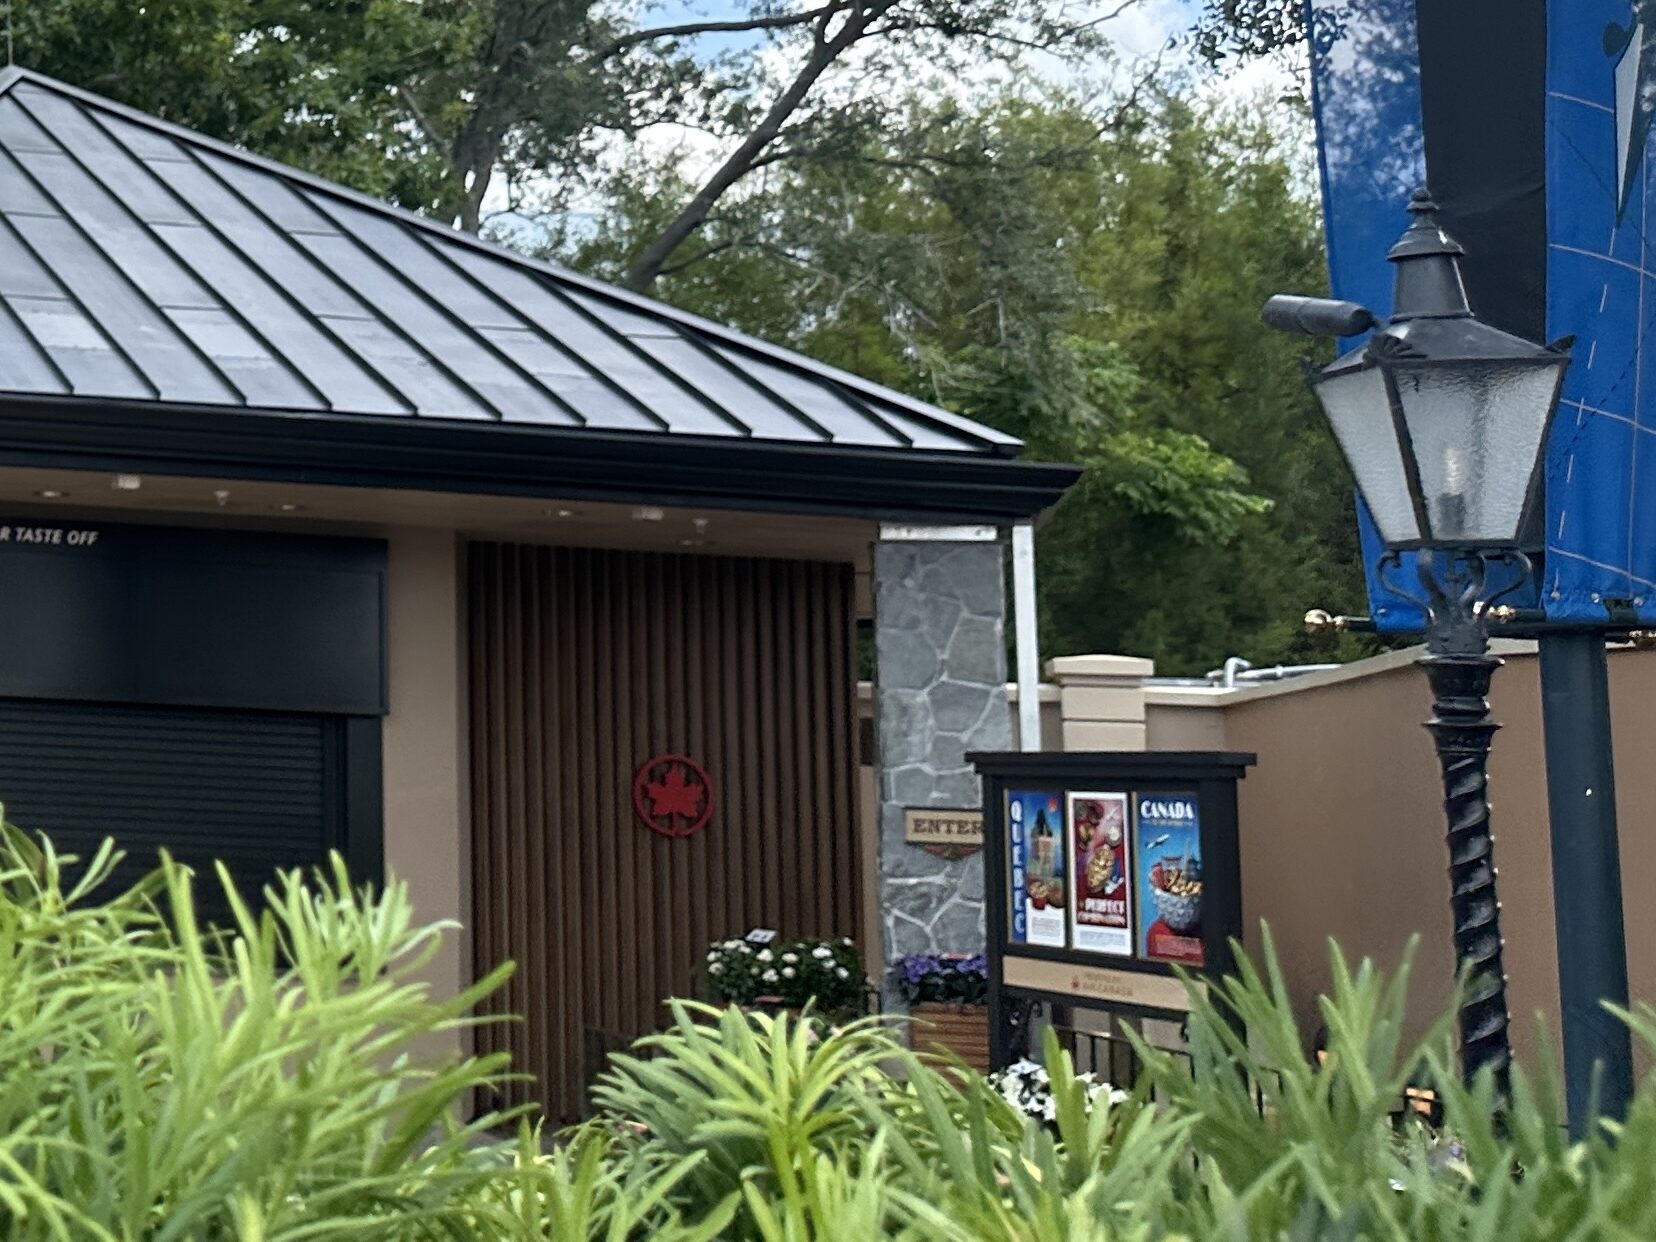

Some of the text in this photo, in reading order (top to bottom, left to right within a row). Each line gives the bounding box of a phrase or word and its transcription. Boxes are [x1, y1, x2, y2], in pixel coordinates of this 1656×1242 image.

[15, 526, 63, 544] TASTE
[67, 530, 98, 546] OFF
[1140, 799, 1194, 819] CANADA
